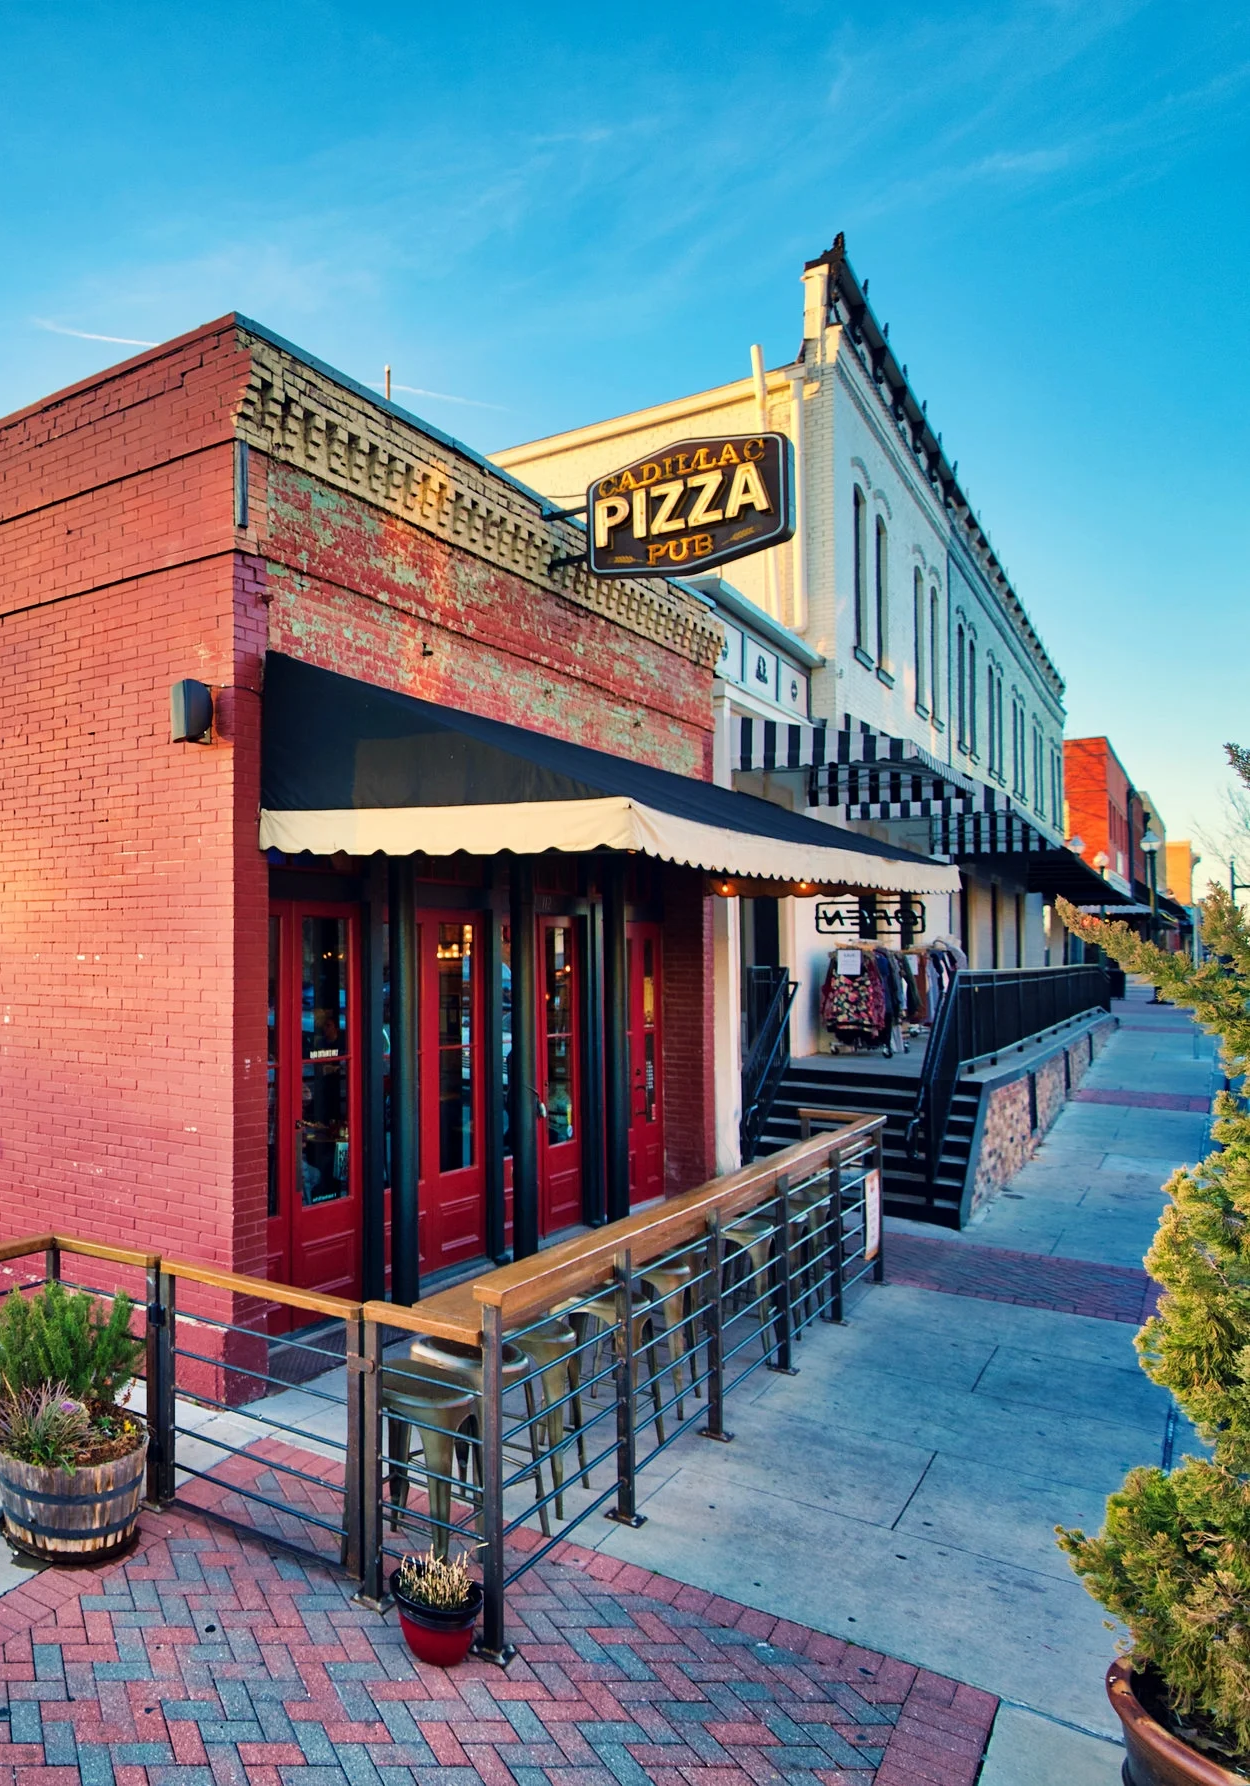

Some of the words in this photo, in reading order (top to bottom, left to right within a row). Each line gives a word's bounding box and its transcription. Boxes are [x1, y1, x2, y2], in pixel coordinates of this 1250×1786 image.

[598, 438, 765, 498] CADILLAC
[594, 461, 773, 549] PIZZA
[646, 532, 714, 566] PUB
